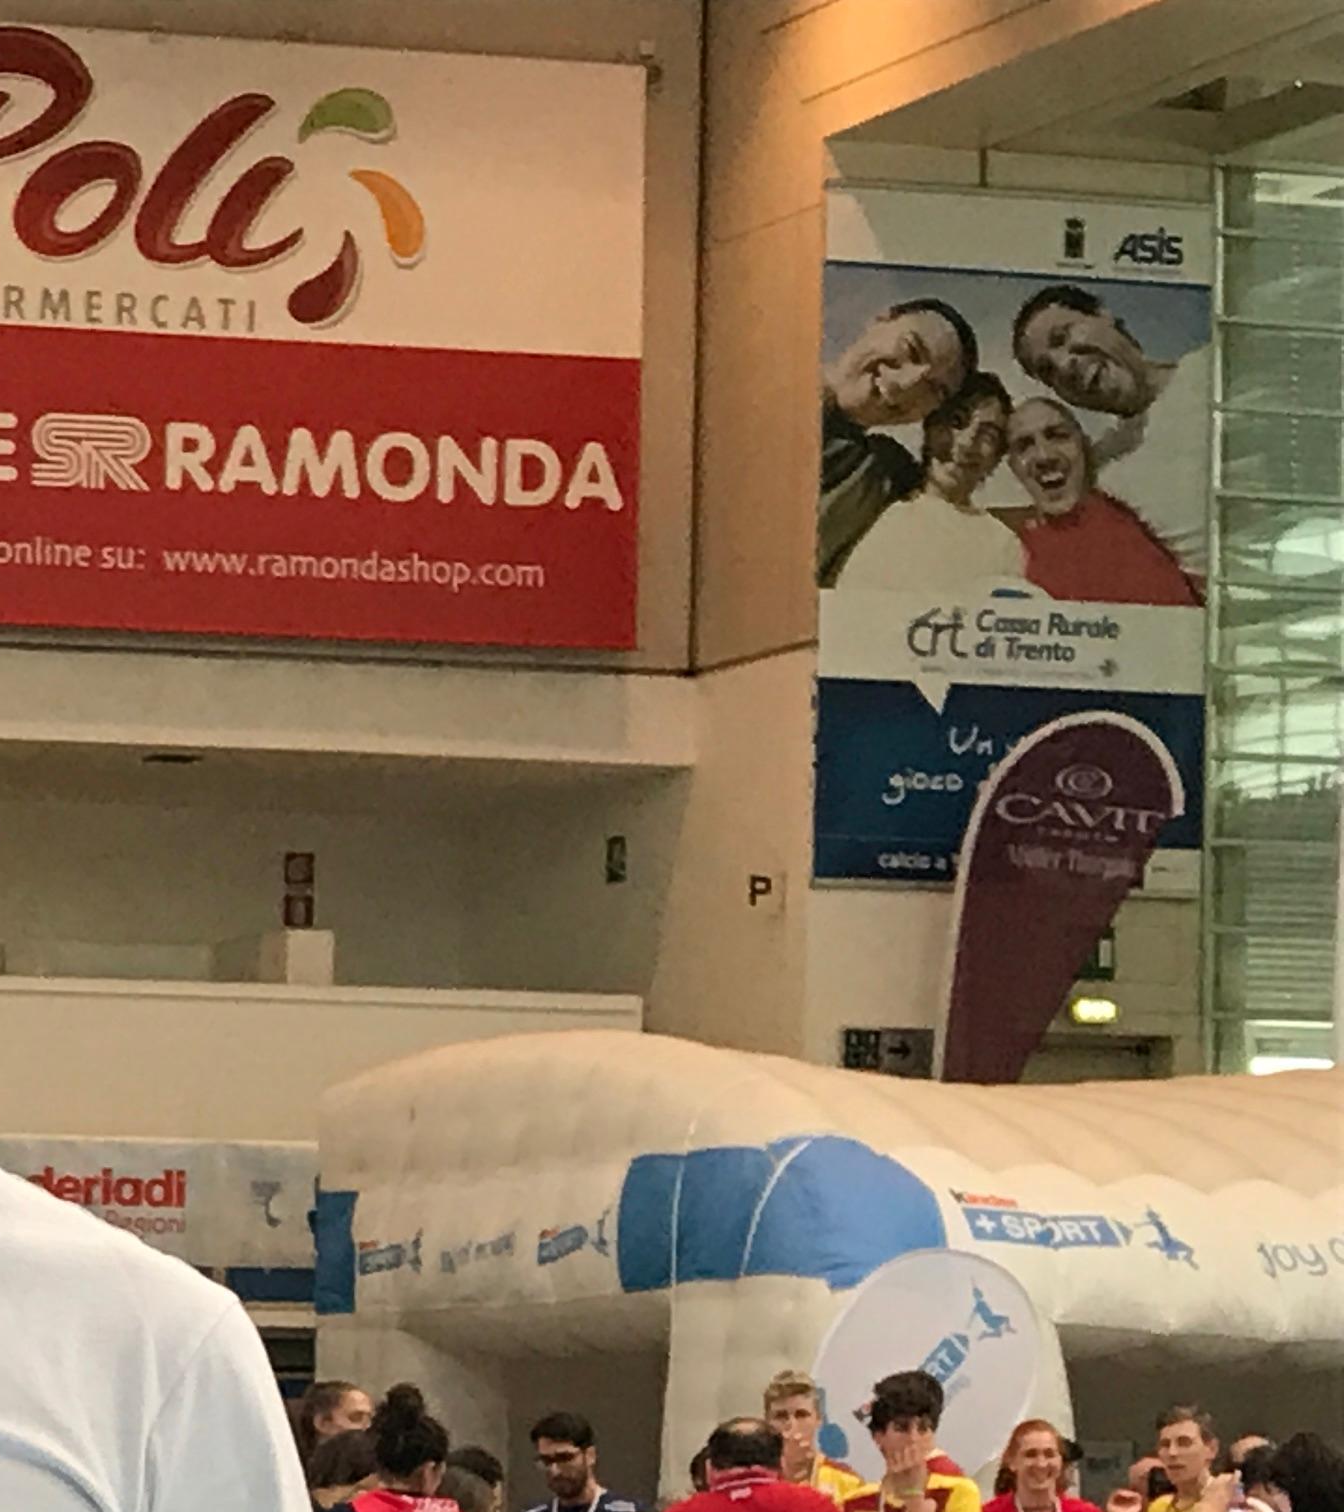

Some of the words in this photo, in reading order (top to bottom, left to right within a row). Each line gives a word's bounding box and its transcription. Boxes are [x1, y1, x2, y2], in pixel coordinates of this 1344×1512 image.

[166, 422, 624, 512] RAMONDA
[99, 543, 146, 571] su:
[162, 546, 546, 592] www.ramondashop.com
[976, 608, 1041, 635] Cassa
[1048, 612, 1121, 640] Rurale
[975, 636, 996, 659] di
[1005, 637, 1076, 662] Trento
[748, 873, 773, 907] P
